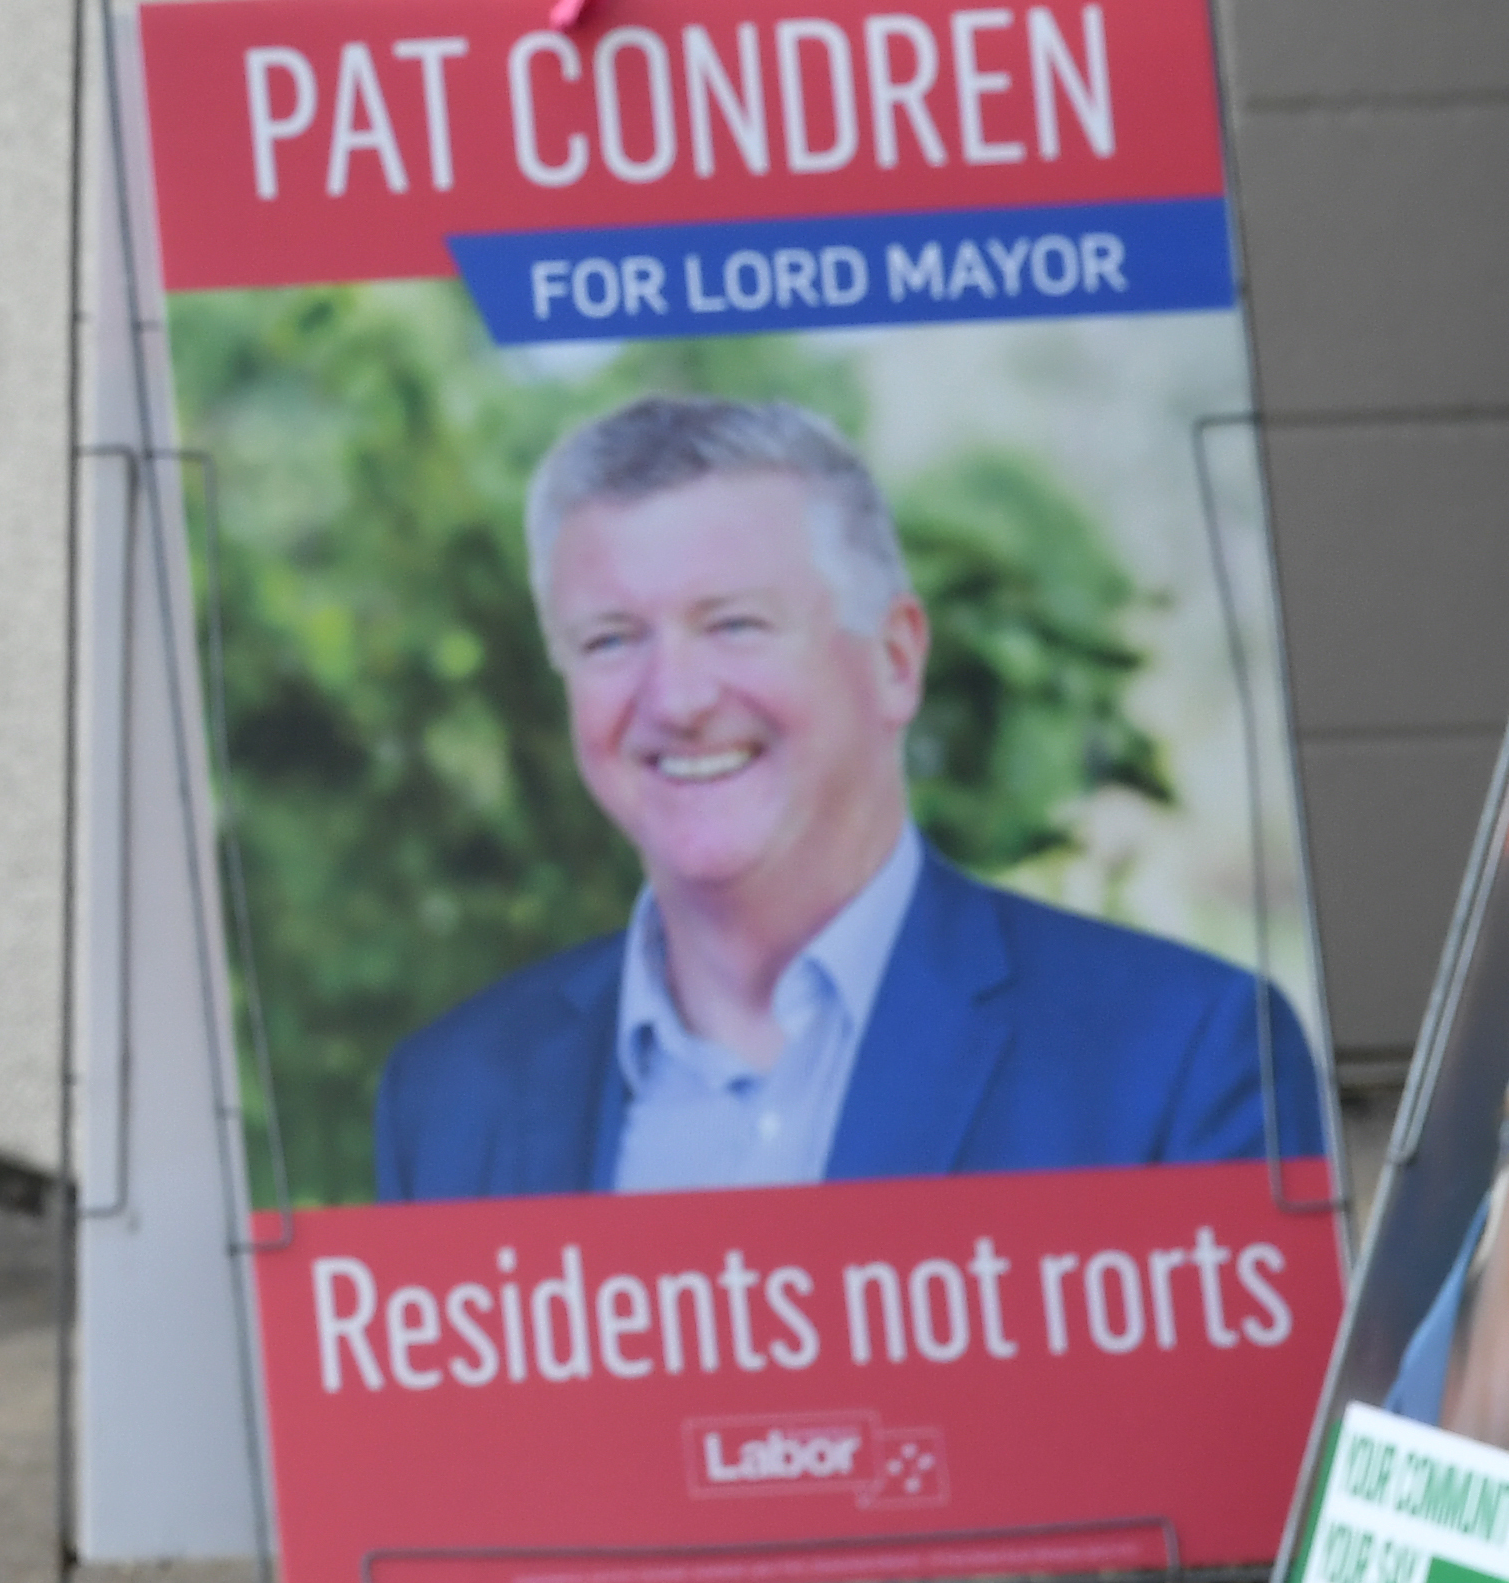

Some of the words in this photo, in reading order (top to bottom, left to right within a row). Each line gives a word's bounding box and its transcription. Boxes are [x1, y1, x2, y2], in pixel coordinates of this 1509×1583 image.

[243, 36, 469, 201] PAT
[506, 4, 1116, 188] CONDREN
[531, 258, 670, 321] FOR
[683, 246, 869, 315] LORD
[886, 232, 1129, 300] MAYOR
[310, 1244, 820, 1395] Residents
[843, 1236, 1017, 1364] not
[1040, 1226, 1293, 1354] rorts
[703, 1429, 861, 1483] Labor
